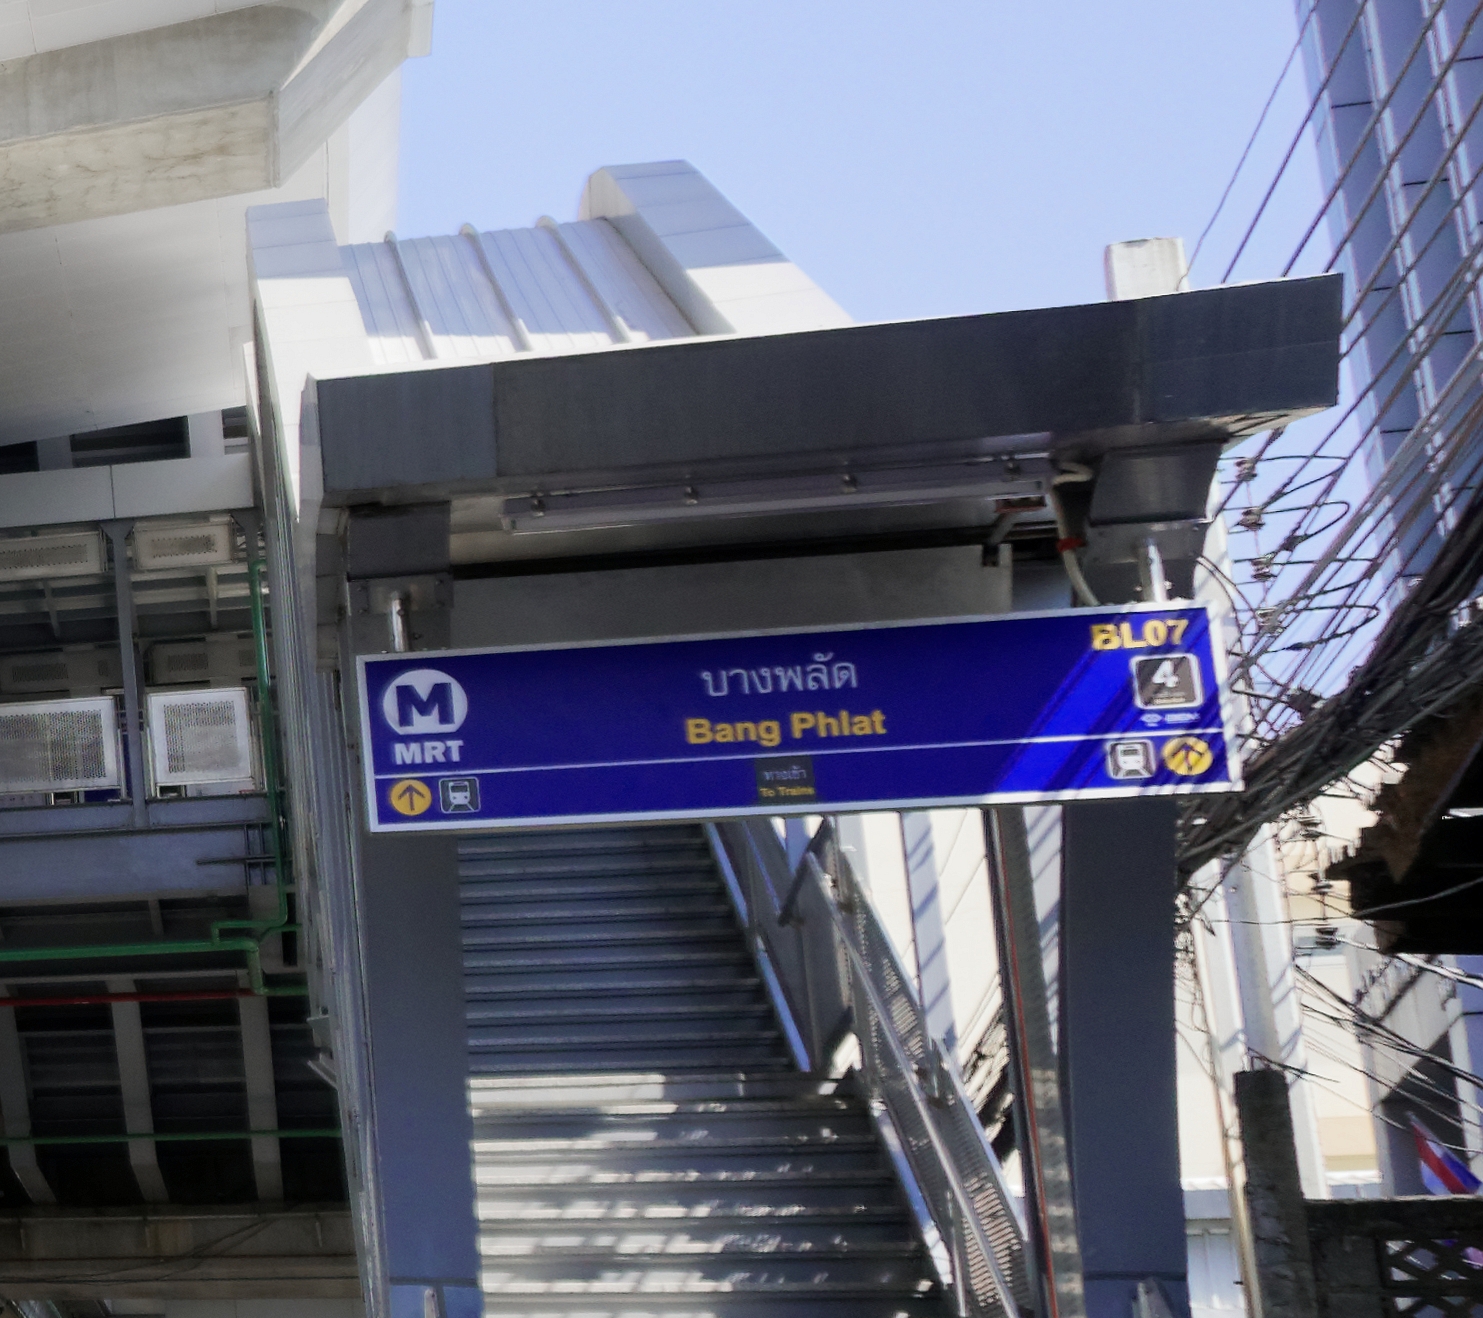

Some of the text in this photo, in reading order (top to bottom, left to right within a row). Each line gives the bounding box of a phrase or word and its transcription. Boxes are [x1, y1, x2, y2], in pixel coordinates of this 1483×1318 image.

[1090, 619, 1189, 651] BL07
[702, 651, 858, 697] บางพลัด
[1152, 660, 1179, 688] 4
[685, 709, 887, 747] Bang Phlat
[394, 740, 464, 765] MRT
